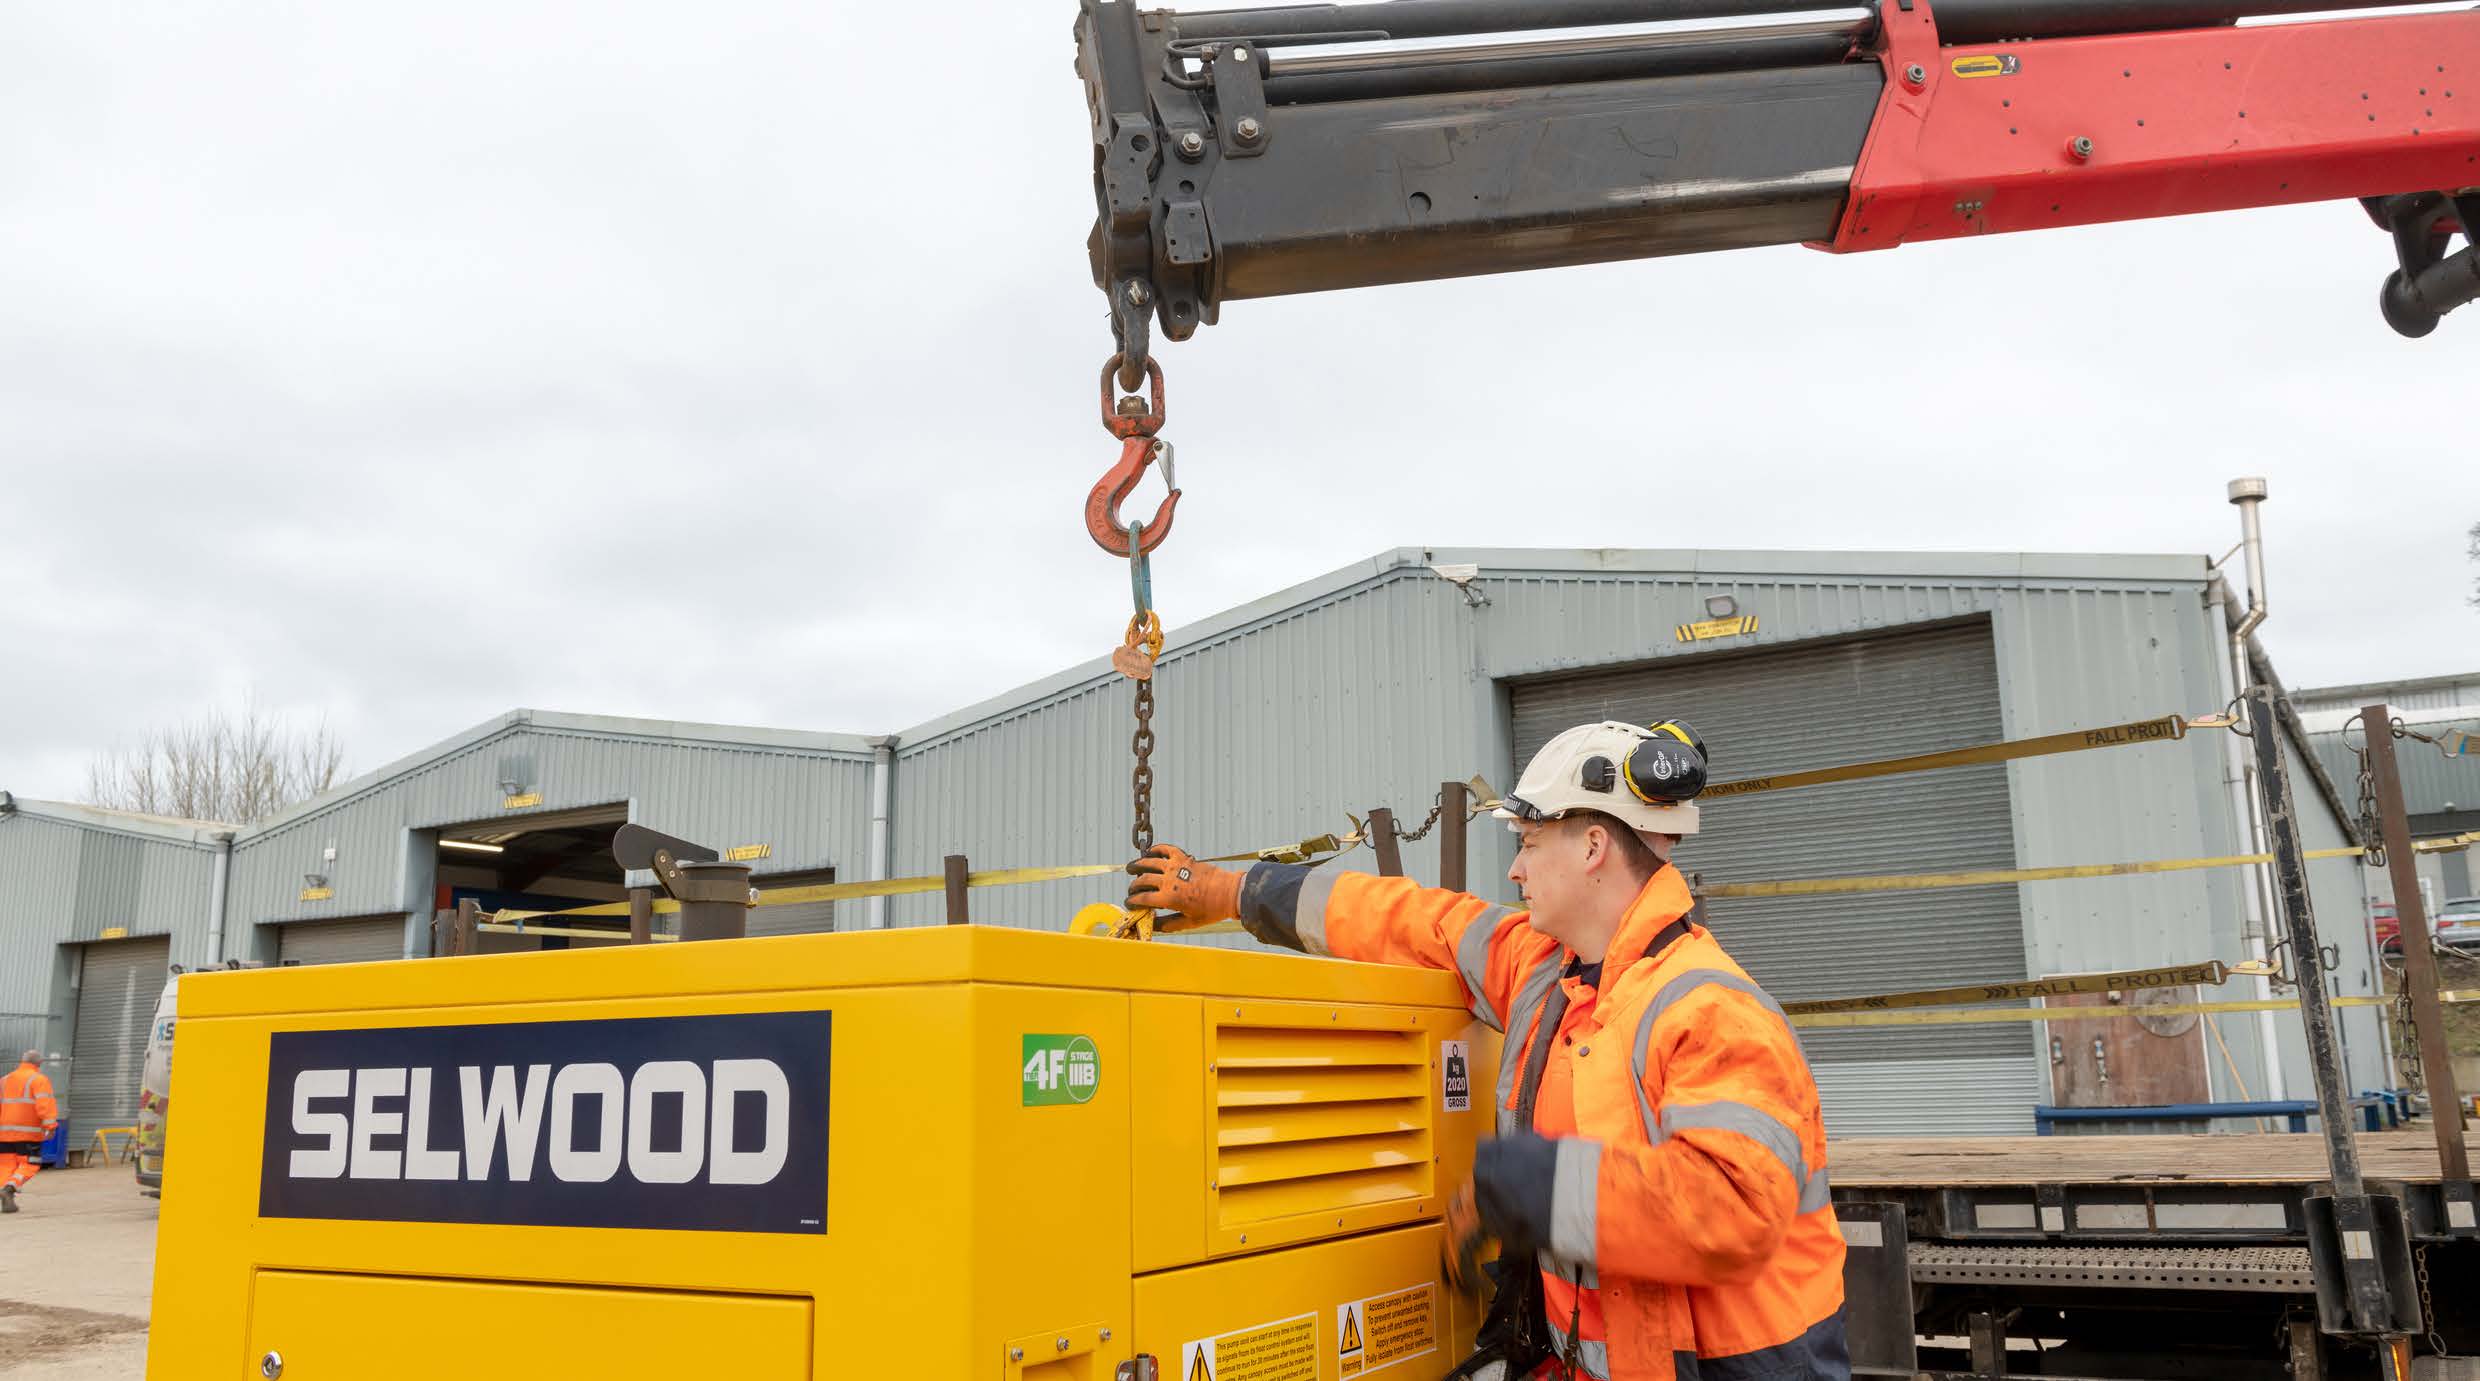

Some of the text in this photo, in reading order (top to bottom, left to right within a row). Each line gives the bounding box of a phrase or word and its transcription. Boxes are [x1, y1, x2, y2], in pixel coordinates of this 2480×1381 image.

[2084, 726, 2126, 745] FALL
[2015, 979, 2087, 997] FALL
[1024, 1049, 1067, 1090] 4F
[1452, 1063, 1460, 1075] kg
[1447, 1077, 1466, 1092] 2020
[1447, 1097, 1467, 1108] GROSS
[289, 1058, 790, 1185] SELWOOD
[1369, 1302, 1385, 1312] Access
[1386, 1298, 1402, 1308] canopy
[1375, 1312, 1391, 1325] prevent
[1371, 1325, 1386, 1337] Switch
[1227, 1340, 1239, 1350] pump
[1376, 1338, 1389, 1349] Apply
[1222, 1352, 1238, 1363] signals
[1366, 1352, 1377, 1364] Fully
[1342, 1360, 1361, 1372] Warning
